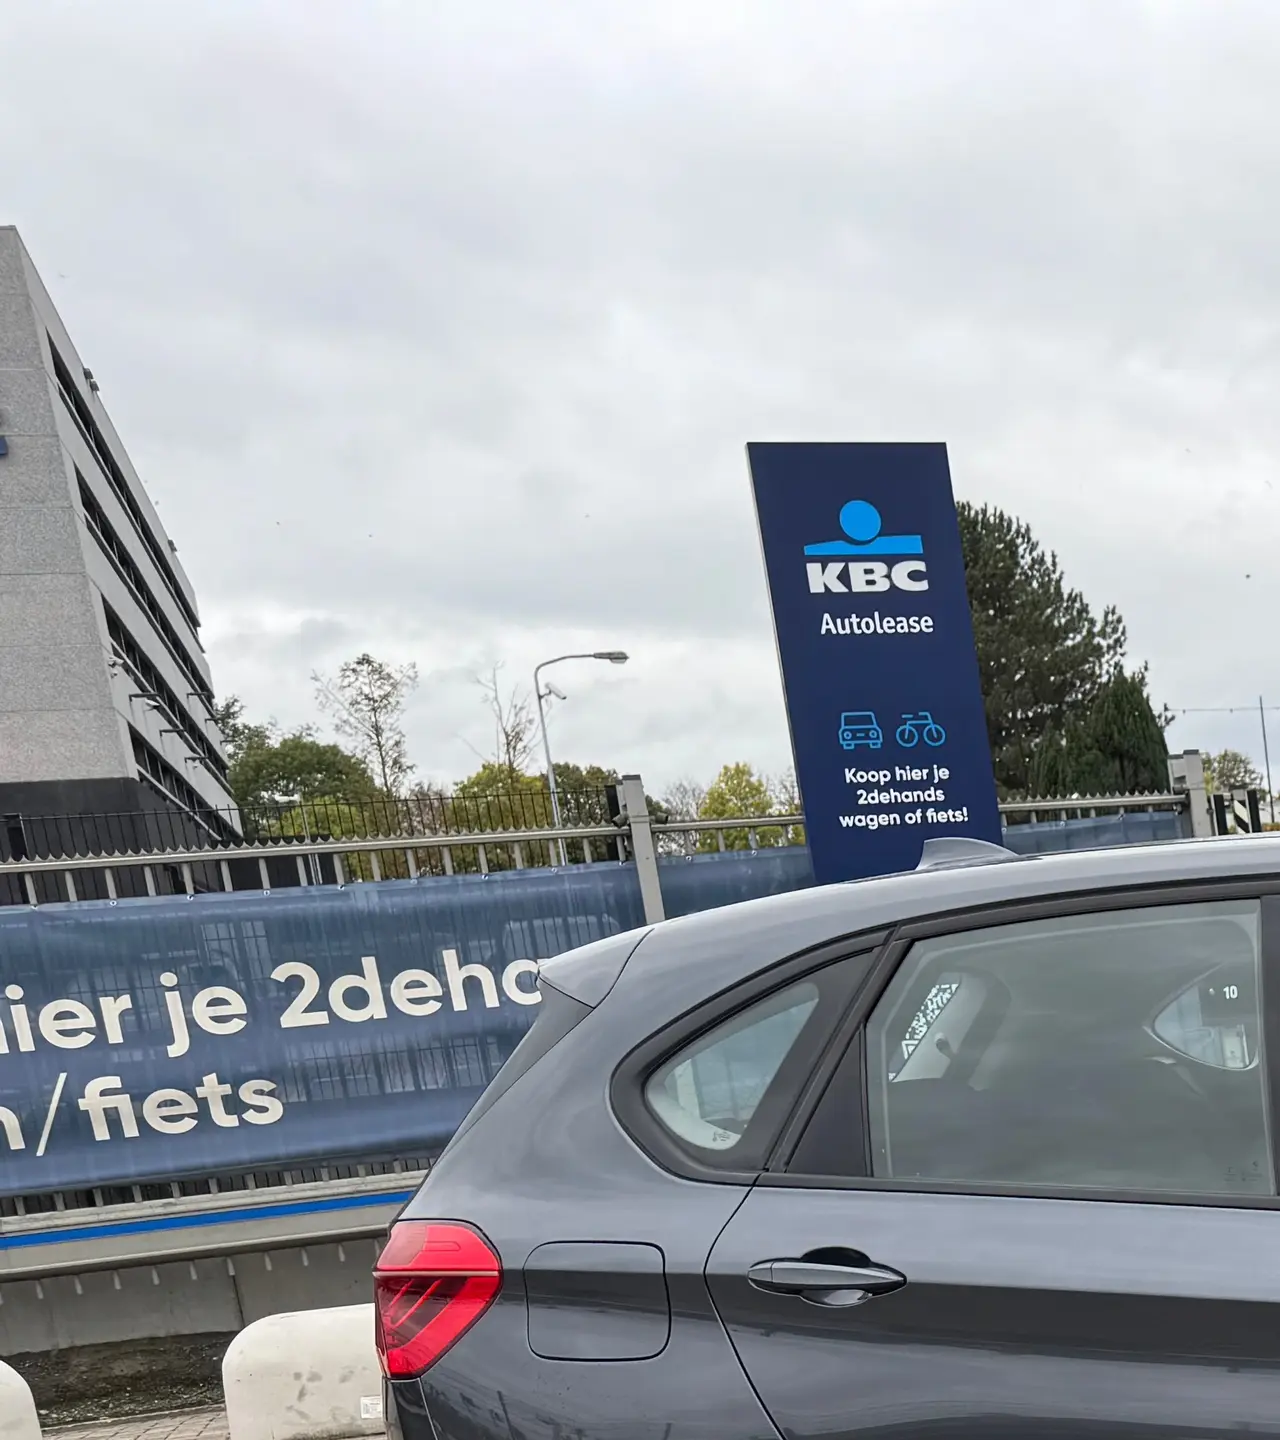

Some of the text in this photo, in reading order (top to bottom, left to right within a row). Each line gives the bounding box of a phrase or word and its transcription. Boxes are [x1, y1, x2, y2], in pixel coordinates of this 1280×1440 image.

[805, 560, 929, 594] KBC
[820, 611, 934, 635] Autolease
[844, 763, 950, 786] Koop hier je
[856, 786, 945, 805] 2dehands
[838, 806, 969, 830] wagen of fiets!
[1223, 985, 1238, 999] 10
[160, 971, 248, 1058] je
